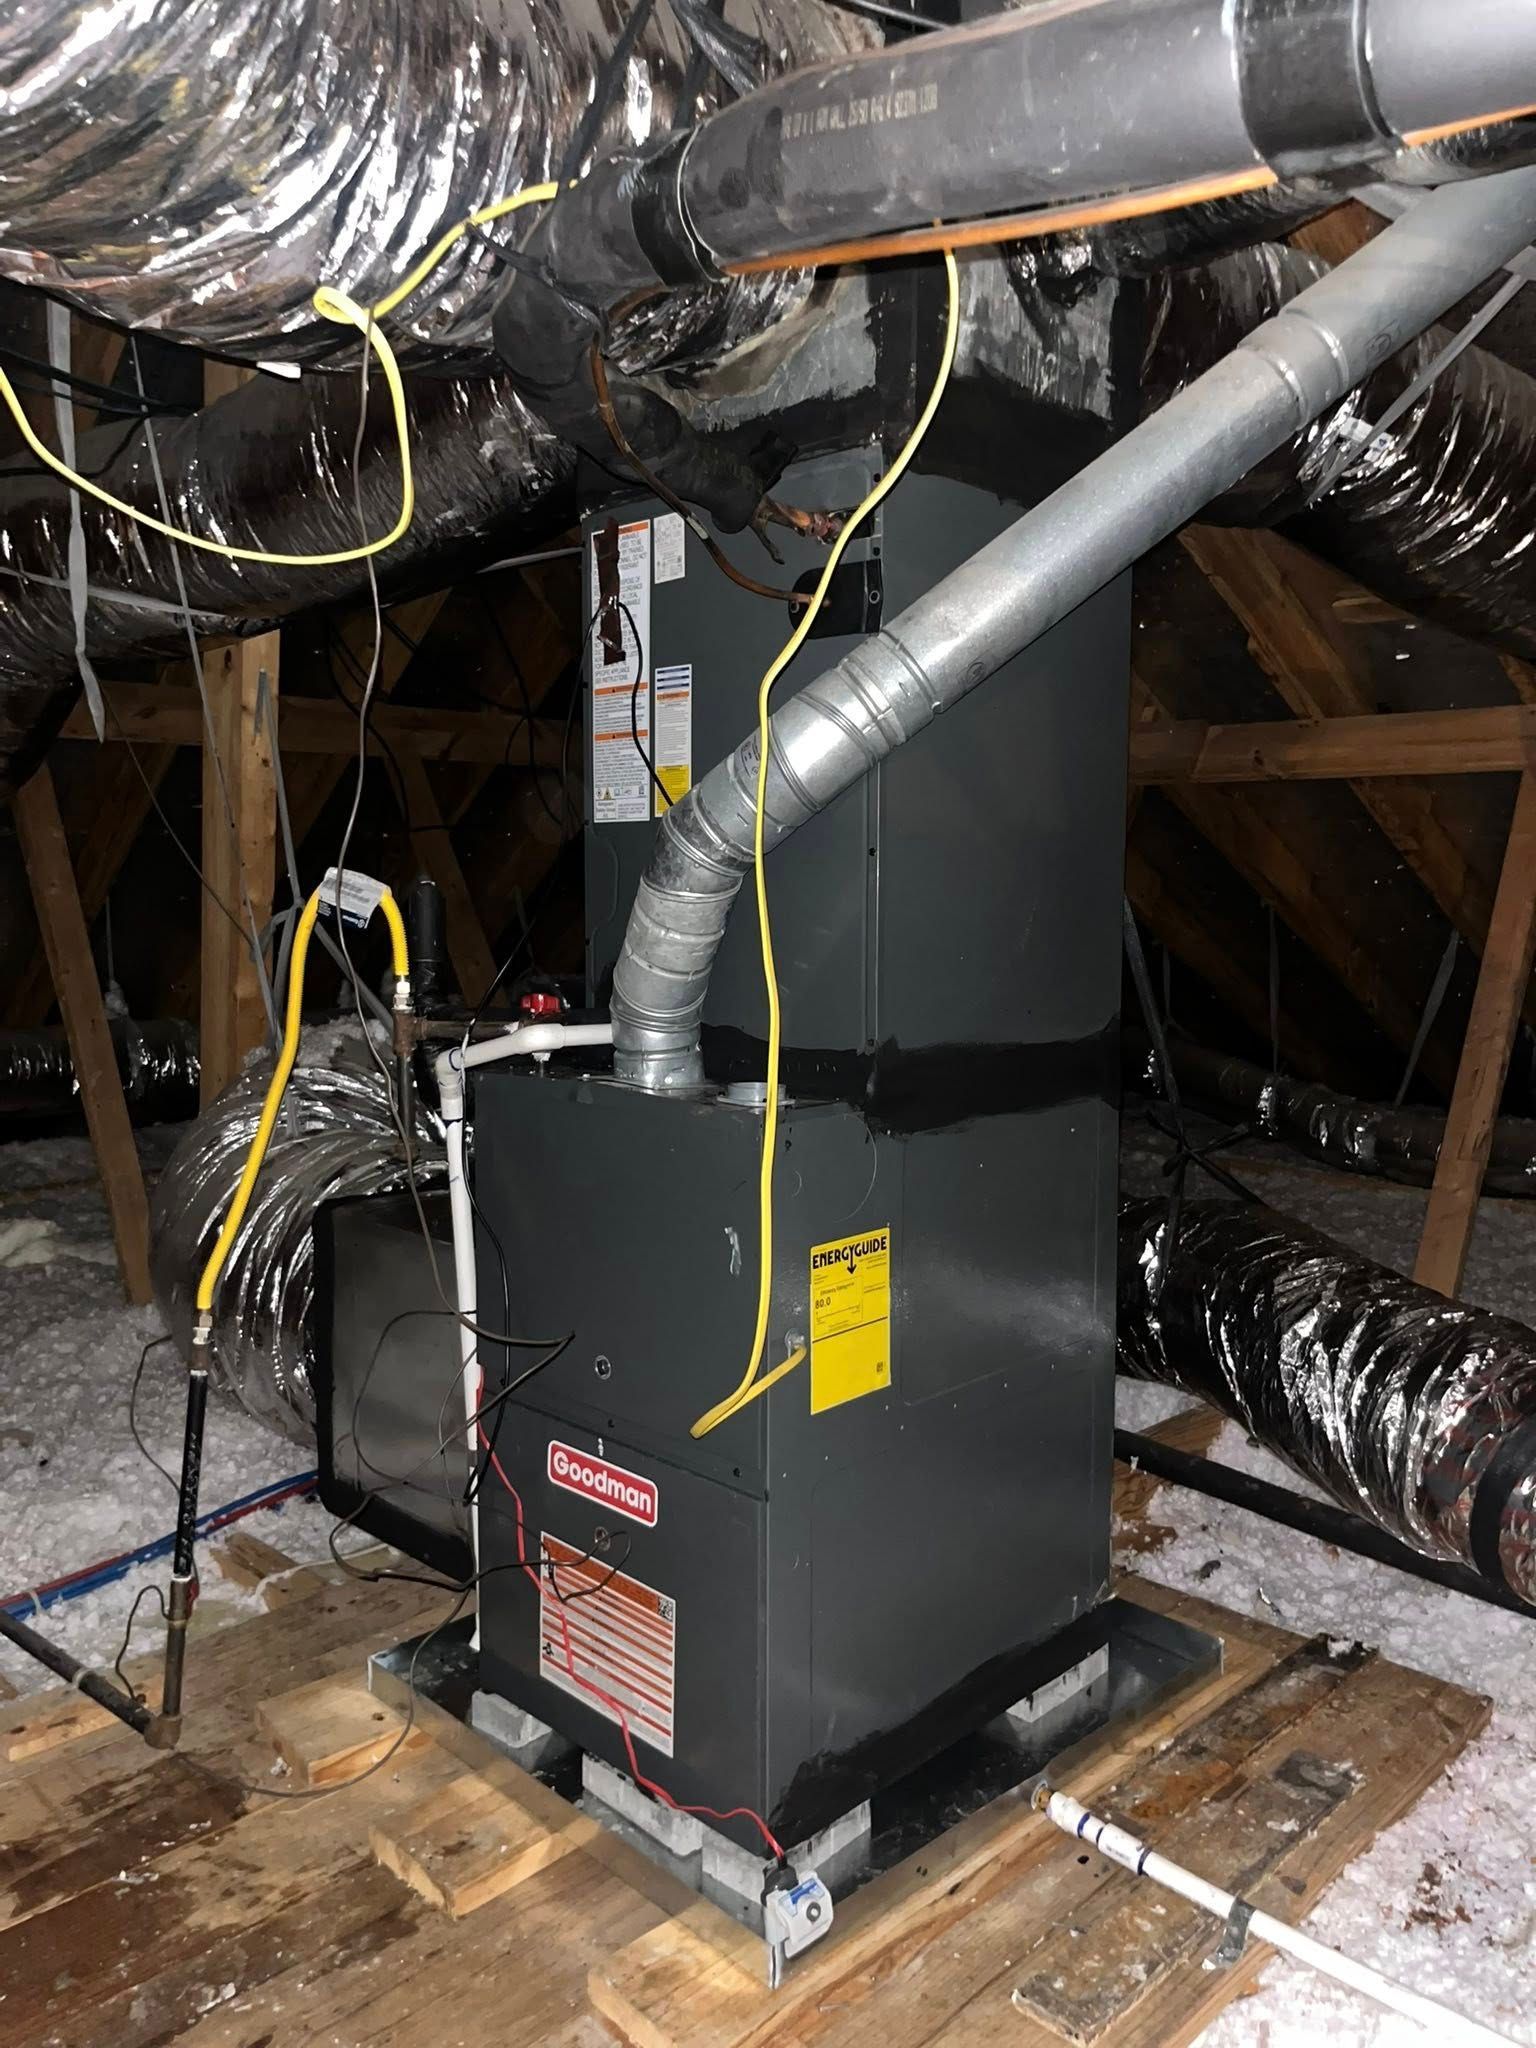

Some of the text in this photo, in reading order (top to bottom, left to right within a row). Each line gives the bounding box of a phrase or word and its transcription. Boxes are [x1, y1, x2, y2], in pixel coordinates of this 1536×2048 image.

[812, 1236, 887, 1269] ENERGYGUIDE
[815, 1297, 831, 1309] 80.0
[553, 1451, 652, 1514] Goodman
